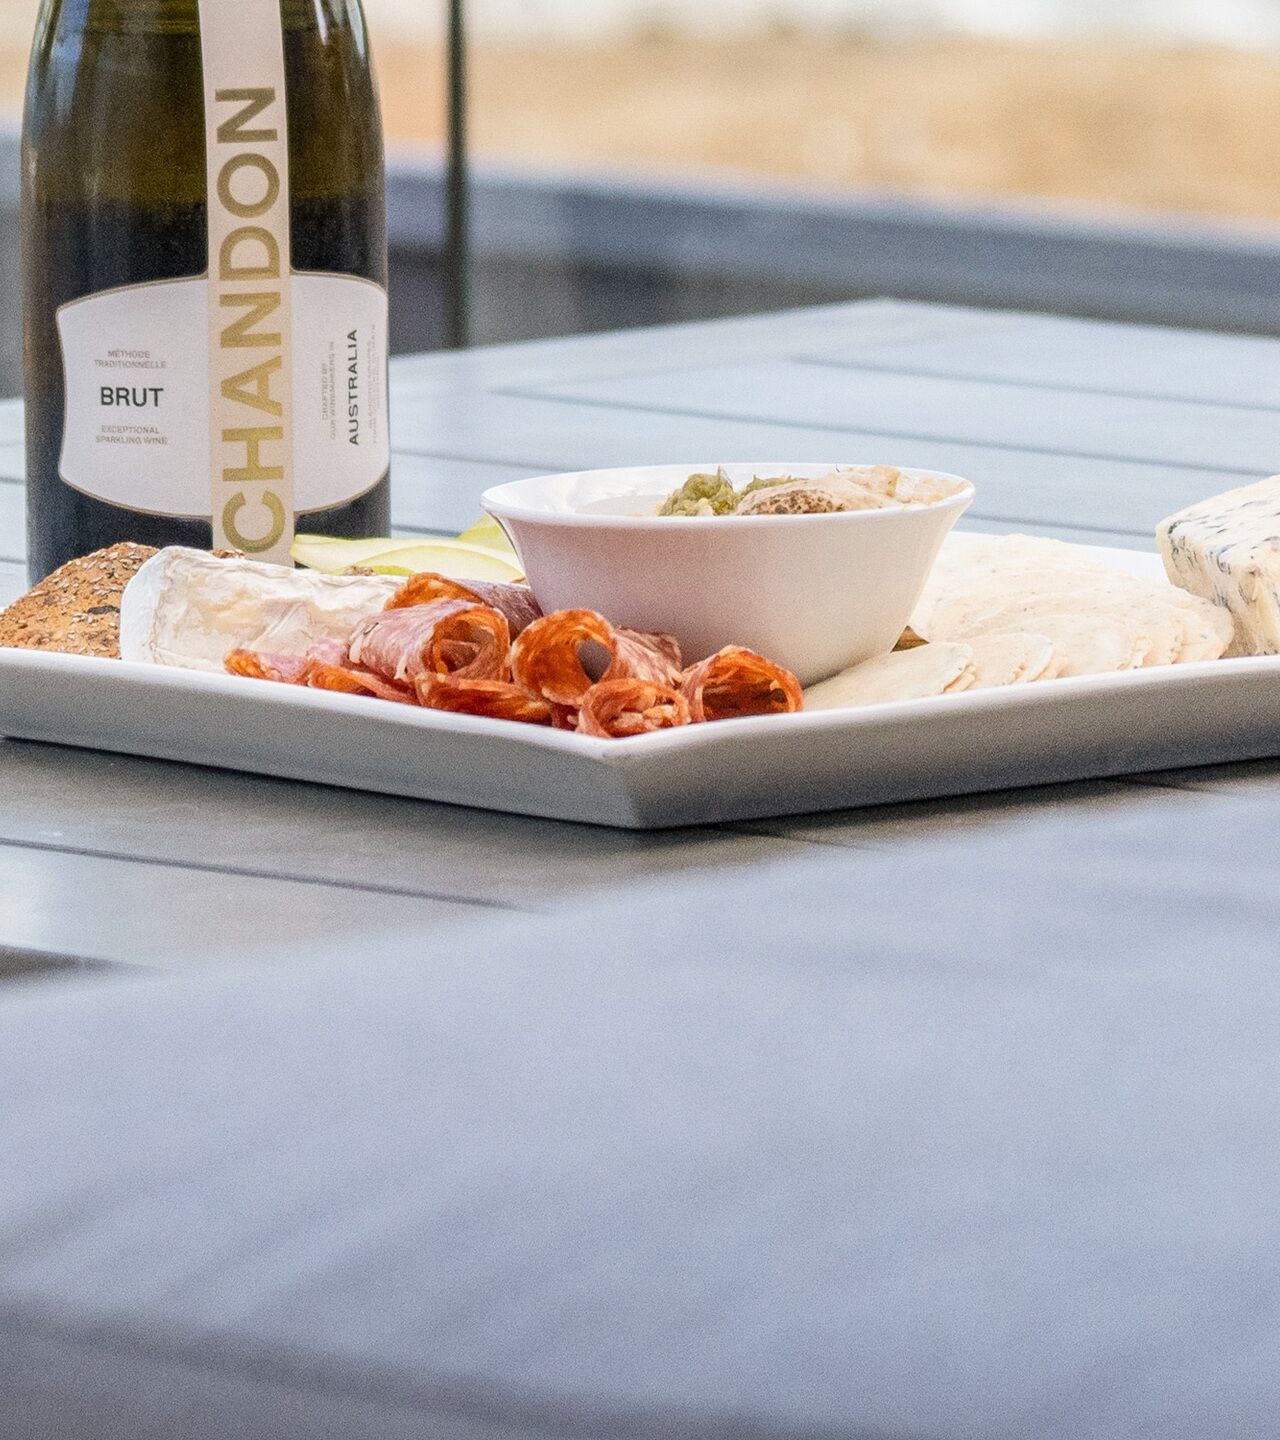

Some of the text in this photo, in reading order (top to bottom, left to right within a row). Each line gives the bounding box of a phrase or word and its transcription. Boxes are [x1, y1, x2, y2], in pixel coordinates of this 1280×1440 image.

[213, 85, 286, 555] CHANDON
[94, 359, 167, 369] TRADITIONNELLE
[347, 329, 359, 446] AUSTRALIA
[100, 386, 164, 408] BRUT
[101, 424, 160, 434] EXCEPTIONAL
[95, 435, 168, 446] SPARKLING WINE
